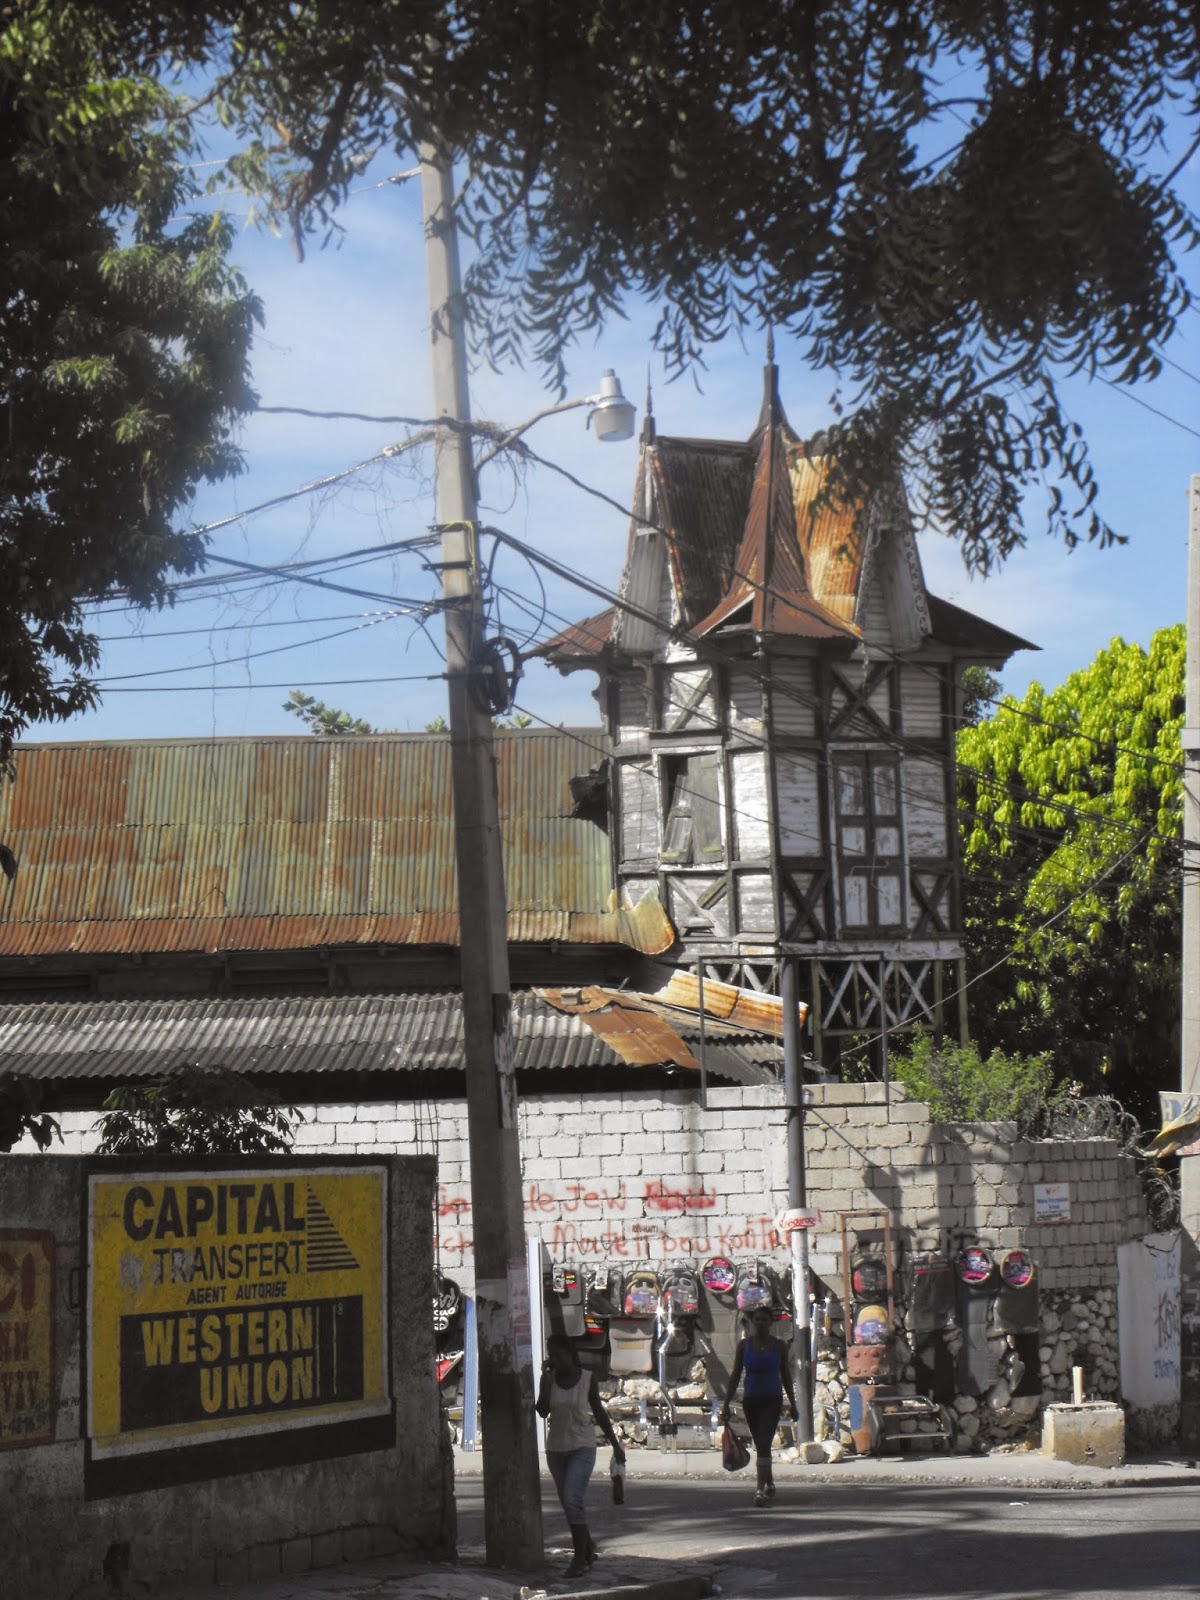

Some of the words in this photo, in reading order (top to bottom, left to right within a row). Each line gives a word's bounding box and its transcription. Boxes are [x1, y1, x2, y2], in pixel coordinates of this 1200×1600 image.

[122, 1182, 306, 1241] CAPITAL
[152, 1240, 306, 1285] TRANSFERT
[187, 1287, 228, 1305] AGENT
[235, 1281, 288, 1301] AUTORISE
[141, 1307, 314, 1367] WESTERN
[200, 1356, 314, 1414] UNION
